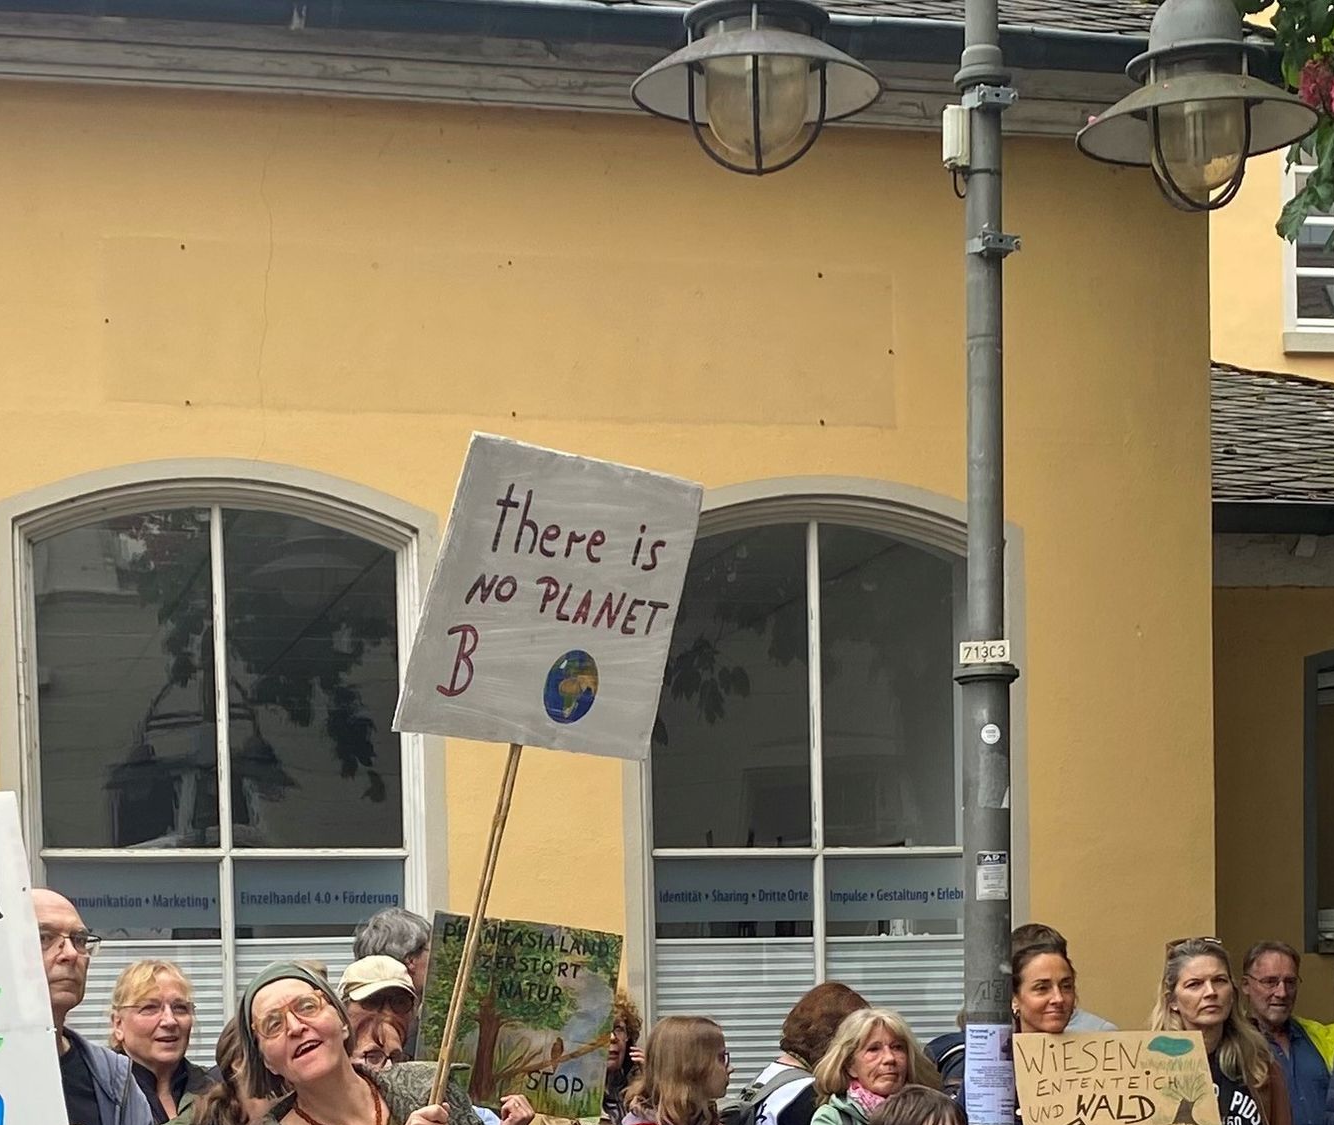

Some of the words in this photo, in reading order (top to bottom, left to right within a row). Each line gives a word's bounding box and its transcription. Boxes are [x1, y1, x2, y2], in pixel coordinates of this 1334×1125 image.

[491, 483, 606, 564] there
[631, 524, 666, 571] is
[465, 573, 517, 605] NO
[536, 575, 669, 636] PLANET
[436, 624, 479, 697] B
[152, 894, 209, 911] Marketing
[240, 890, 312, 905] Einzelhandel
[315, 891, 331, 904] 4.0
[342, 890, 399, 907] Förderung
[659, 888, 703, 903] Identität
[711, 889, 749, 906] Sharing
[758, 888, 786, 902] Dritte
[787, 888, 809, 902] Orte
[830, 888, 868, 904] Impulse
[877, 888, 929, 905] Gestaltung
[499, 980, 563, 1002] NATUR
[526, 1070, 584, 1096] STOP
[1028, 1103, 1064, 1124] UND
[1076, 1094, 1156, 1125] WALD
